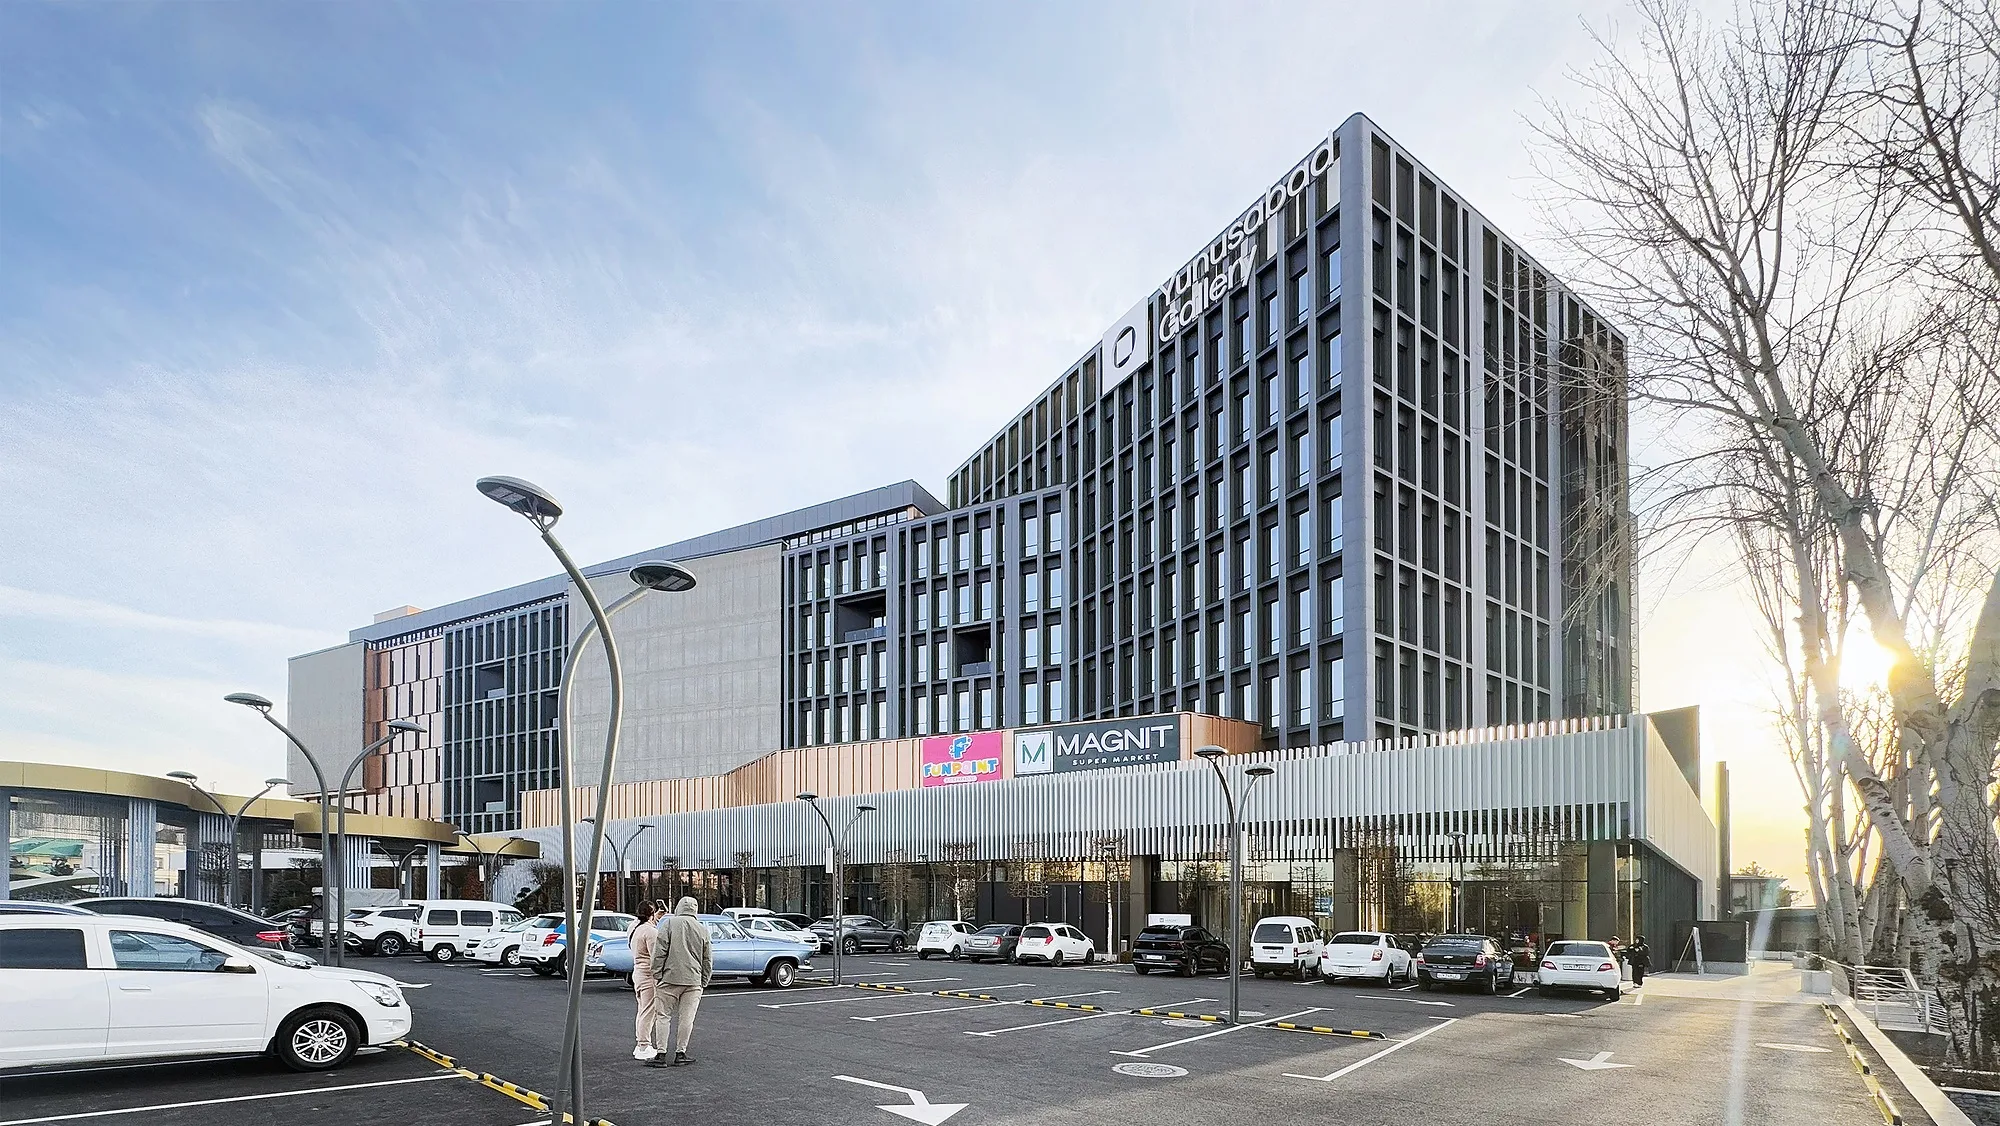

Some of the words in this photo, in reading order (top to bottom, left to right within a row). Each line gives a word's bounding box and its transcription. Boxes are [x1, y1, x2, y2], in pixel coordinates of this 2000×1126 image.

[1159, 129, 1334, 306] Yunusabad
[1160, 244, 1257, 342] Gallery
[1057, 725, 1174, 756] MAGNIT
[923, 758, 999, 777] FUNPOINT
[1072, 757, 1108, 766] SUPER
[1112, 753, 1159, 763] MARKET
